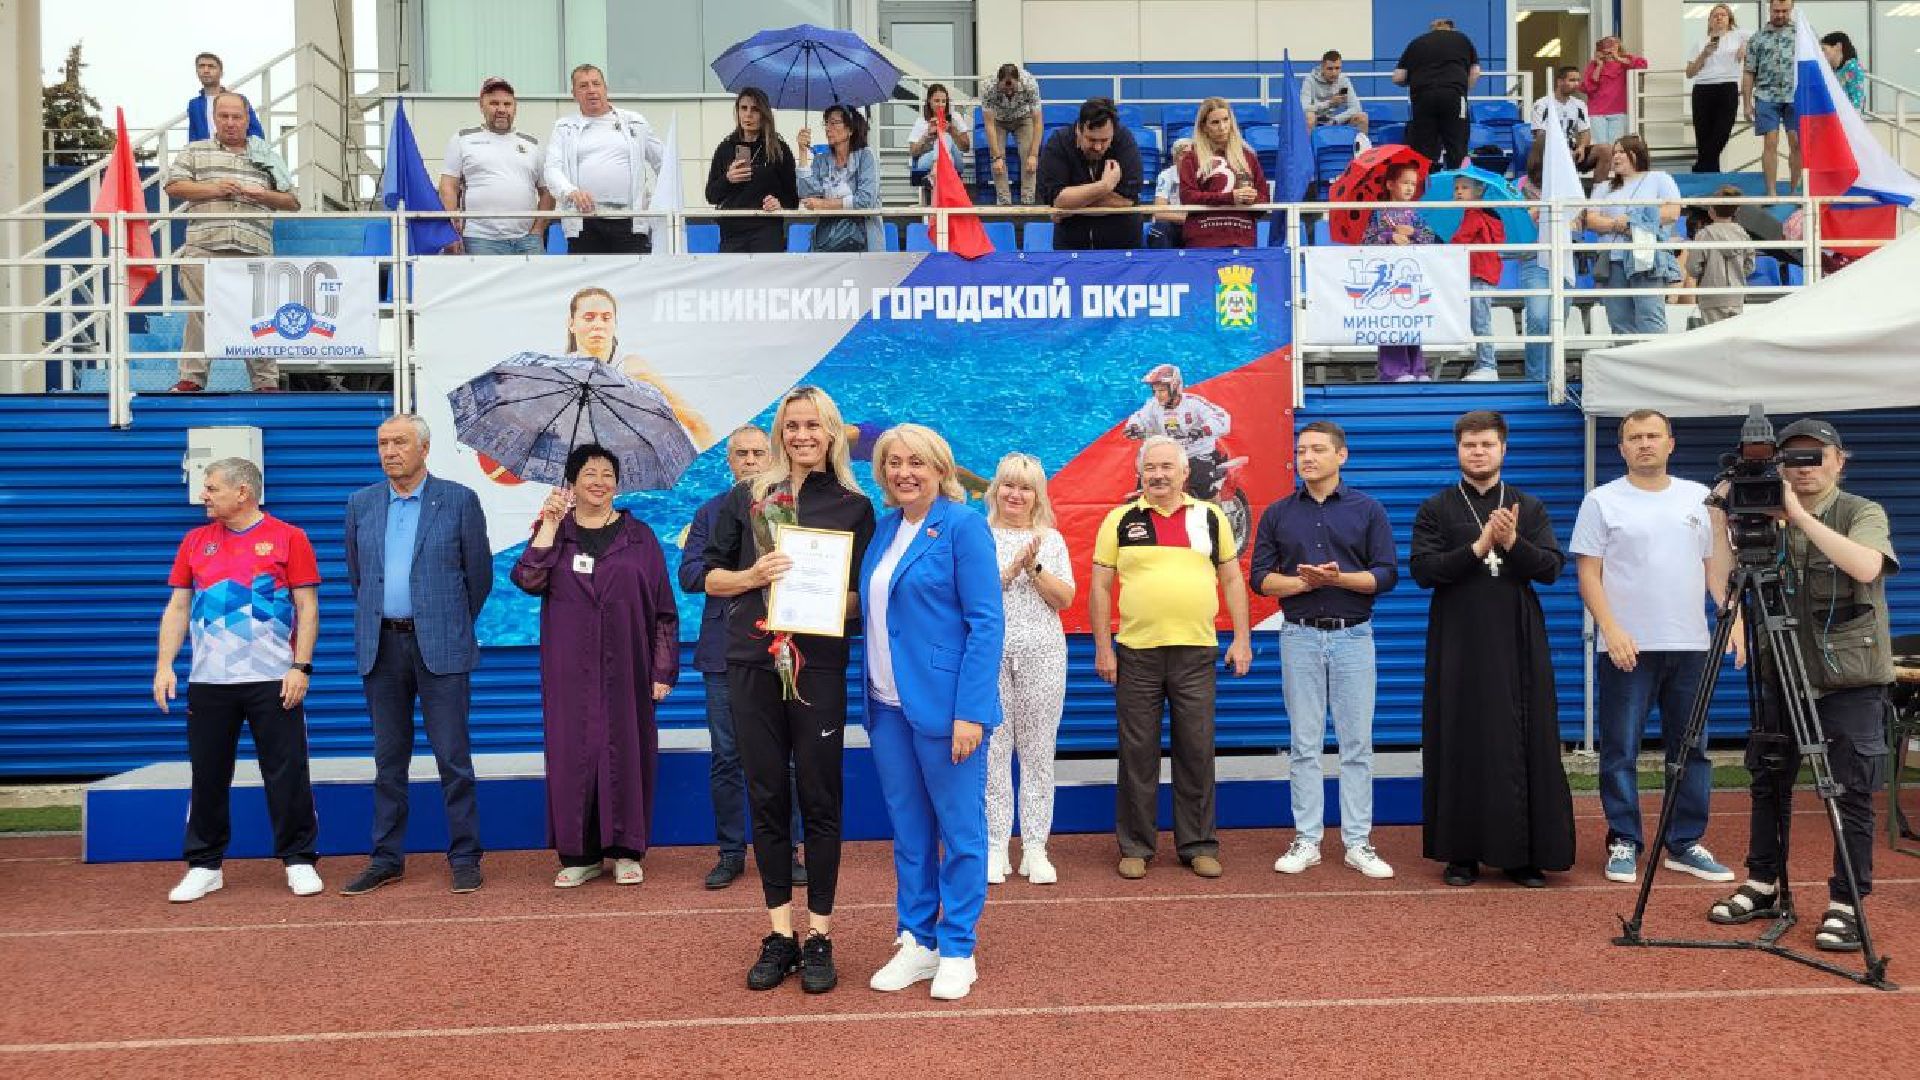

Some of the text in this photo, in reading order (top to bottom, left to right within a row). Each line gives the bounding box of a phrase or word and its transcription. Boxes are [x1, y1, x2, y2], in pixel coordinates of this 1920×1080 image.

[318, 281, 343, 292] ЛЕТ
[653, 276, 1190, 323] ЛЕНИНСКИЙ ГОРОДСКОЙ ОКРУГ
[1343, 314, 1433, 329] МИНСПОРТ
[1355, 330, 1421, 345] РОССИИ
[225, 345, 365, 356] МИНИСТЕРСТВО СПОРТА
